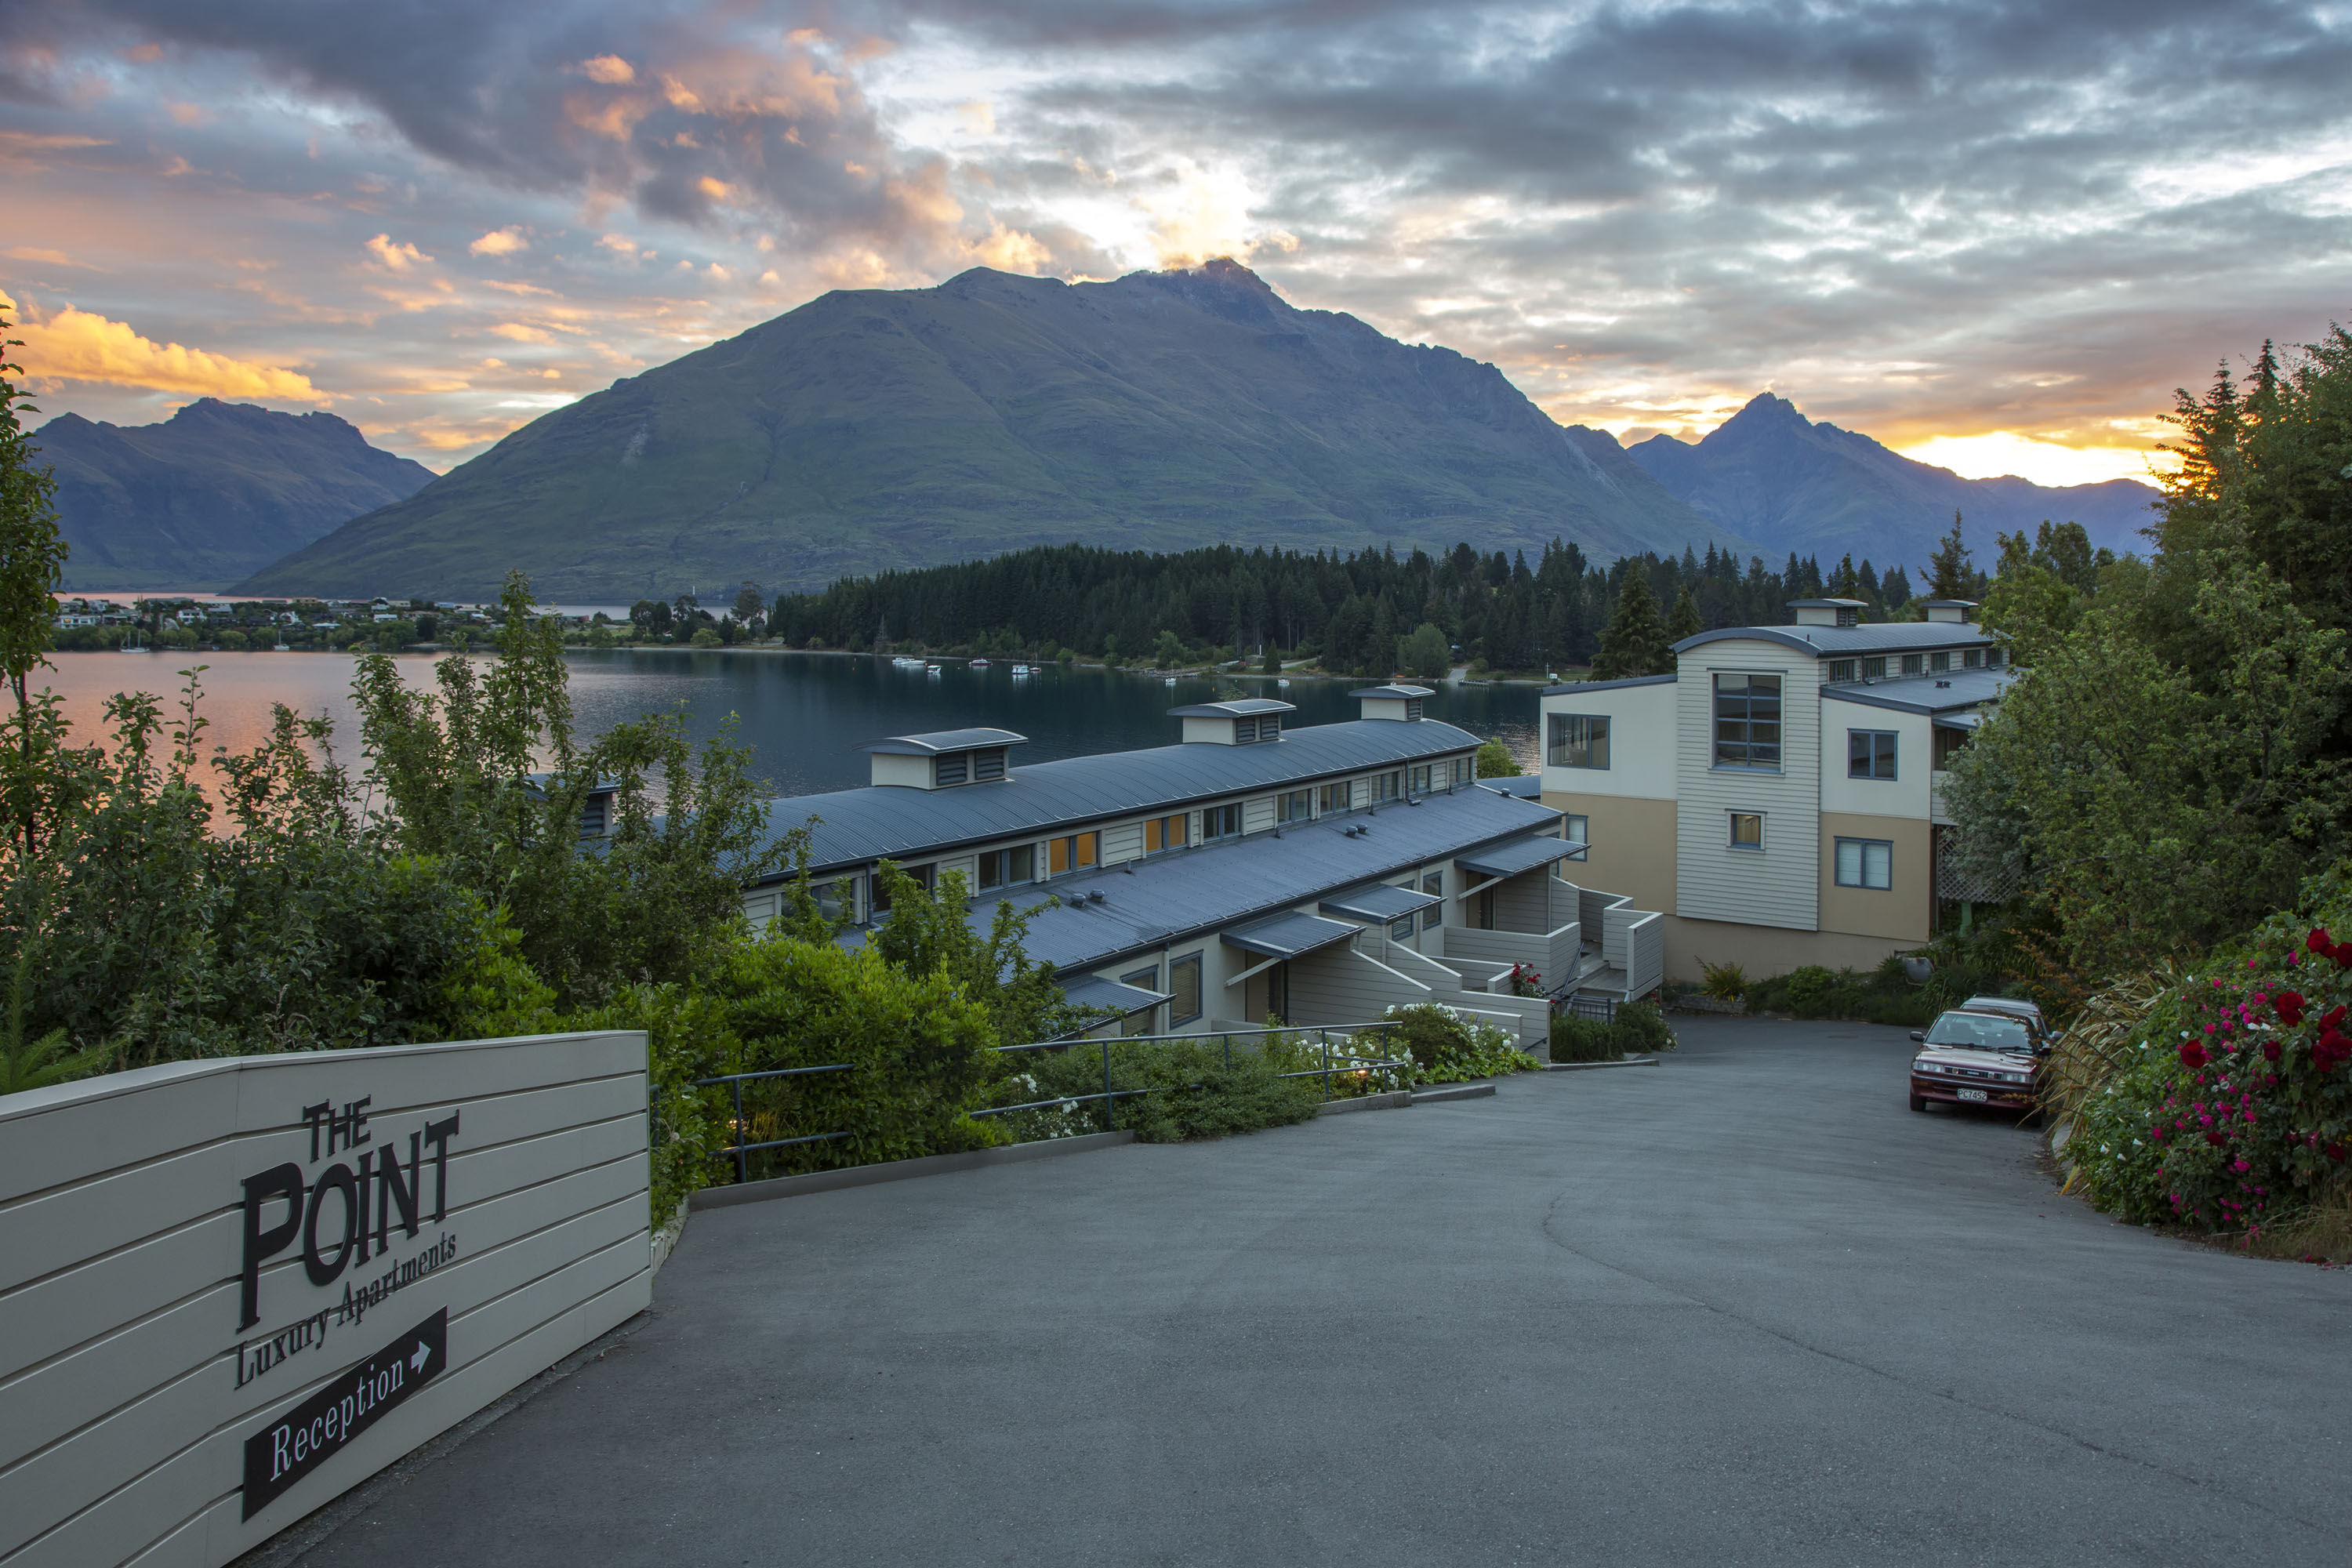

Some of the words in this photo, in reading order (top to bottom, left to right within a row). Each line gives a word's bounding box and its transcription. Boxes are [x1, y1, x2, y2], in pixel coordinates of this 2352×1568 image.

[303, 1094, 371, 1163] THE
[1958, 1090, 1987, 1100] PC7452
[236, 1109, 459, 1334] POINT
[234, 1307, 331, 1392] Luxury
[336, 1232, 456, 1327] Apartments
[270, 1359, 405, 1482] Reception
